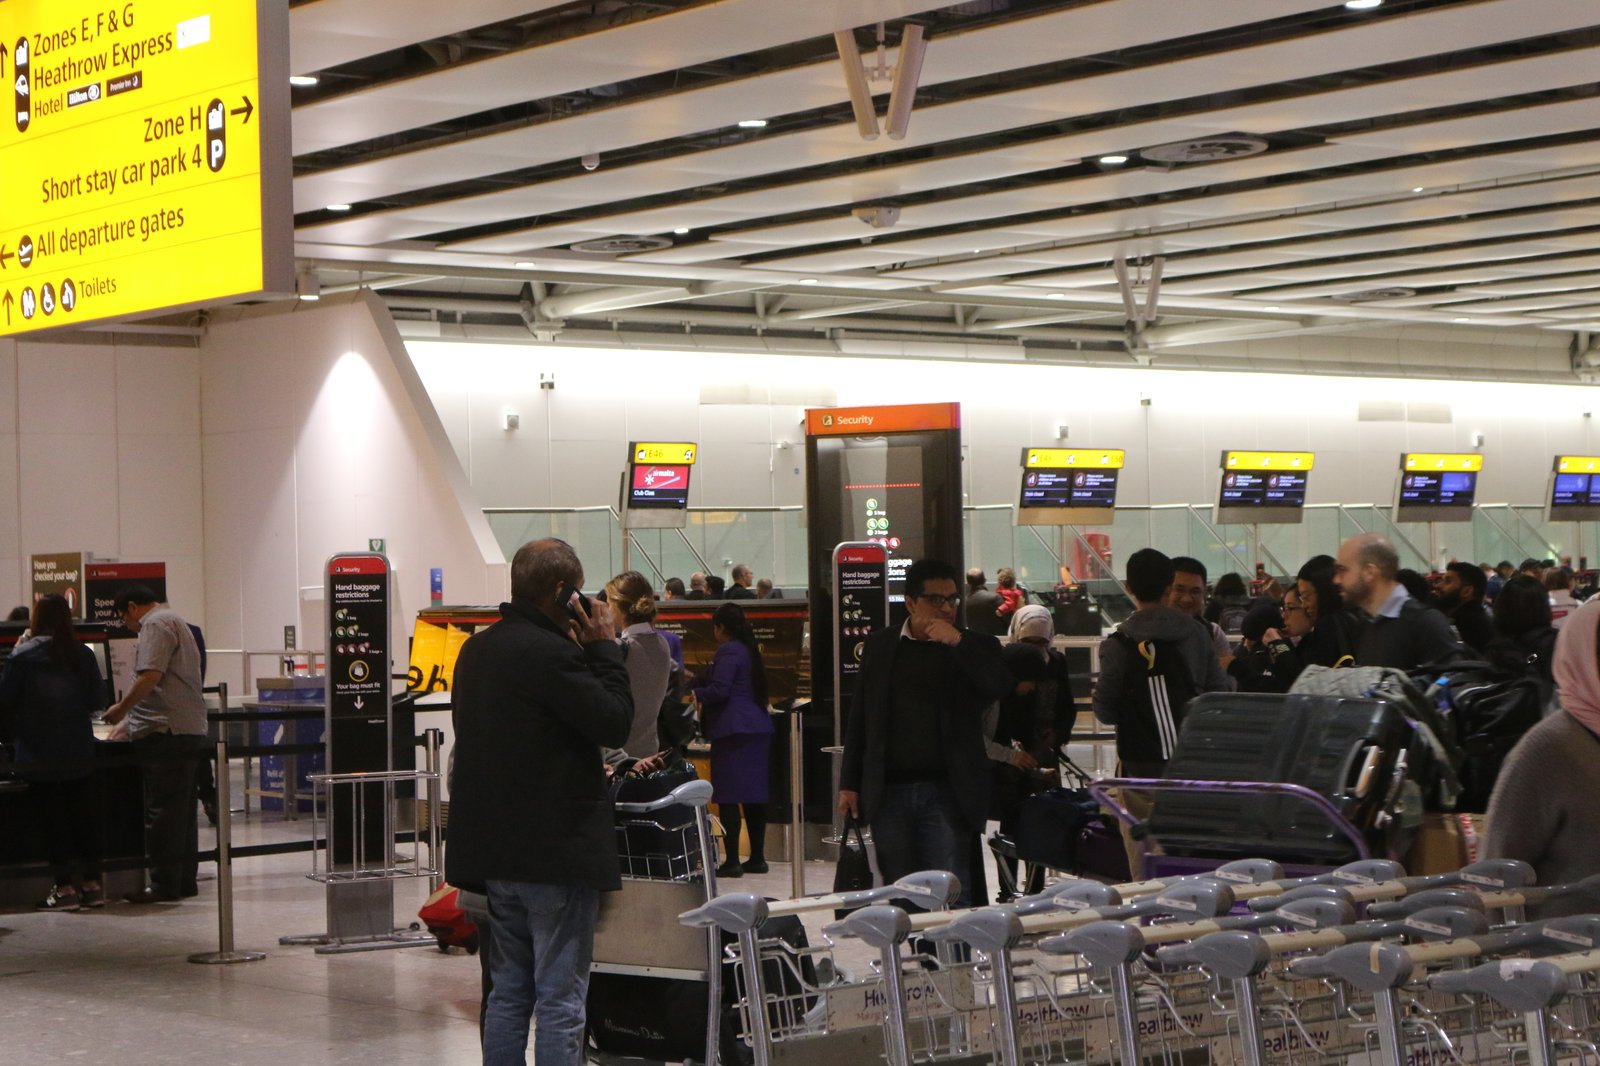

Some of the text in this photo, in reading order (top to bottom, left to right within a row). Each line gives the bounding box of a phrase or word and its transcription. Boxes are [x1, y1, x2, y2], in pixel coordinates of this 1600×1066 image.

[33, 2, 134, 57] Zones E, F & G
[34, 31, 173, 91] Heathrow Express
[34, 92, 64, 119] Hotel
[68, 90, 88, 105] Hilton
[109, 81, 125, 92] Premier
[144, 104, 202, 143] Zone H
[42, 143, 203, 204] Short stay car park 4
[36, 207, 184, 258] All departure gates
[79, 277, 117, 299] Toilets
[837, 415, 874, 426] Security
[34, 560, 56, 571] Have you
[887, 558, 913, 568] ggage
[54, 572, 65, 583] your
[857, 571, 880, 579] baggage
[353, 584, 380, 592] baggage
[95, 598, 115, 609] Spee
[95, 610, 112, 620] your
[1138, 1013, 1203, 1035] eathrow
[1264, 1029, 1330, 1053] eathrow
